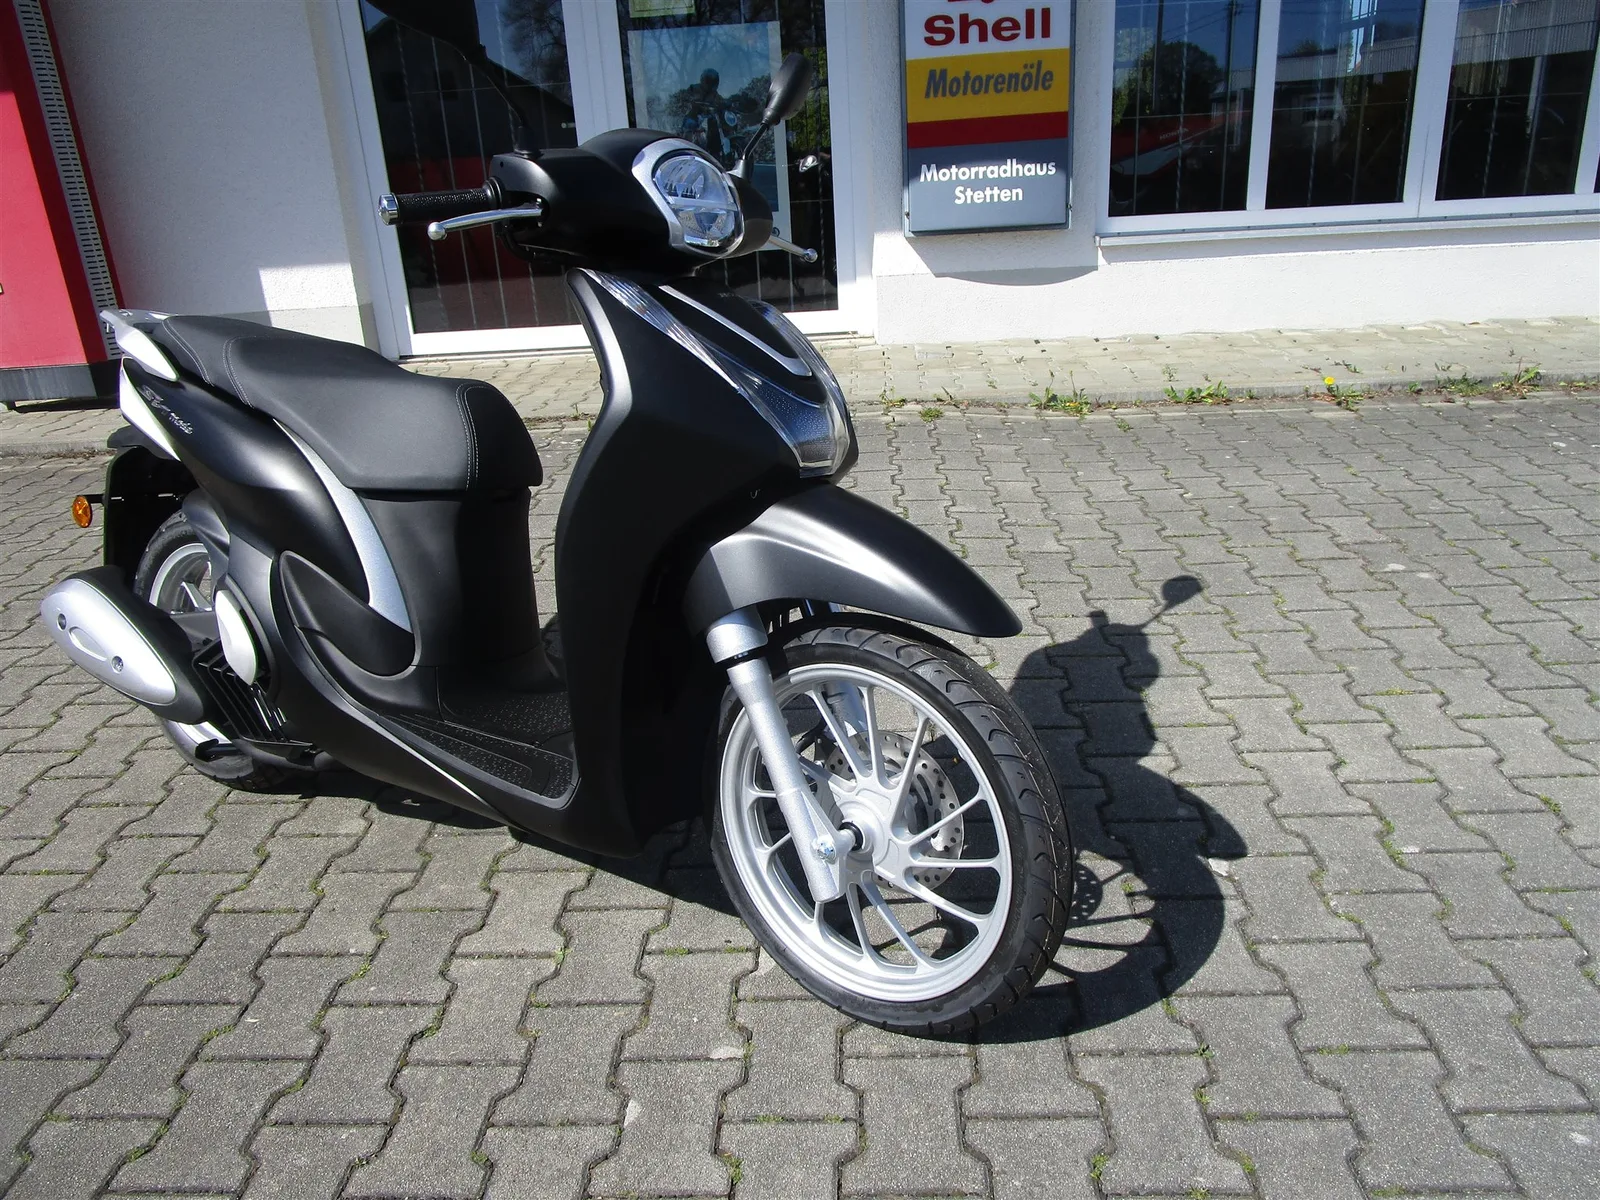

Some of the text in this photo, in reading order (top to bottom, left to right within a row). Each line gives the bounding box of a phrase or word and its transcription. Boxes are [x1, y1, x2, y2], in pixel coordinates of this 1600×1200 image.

[924, 8, 1051, 46] Shell
[925, 60, 1053, 98] Motorenöle
[920, 159, 1056, 182] Motorradhaus
[954, 186, 1023, 205] Stetten
